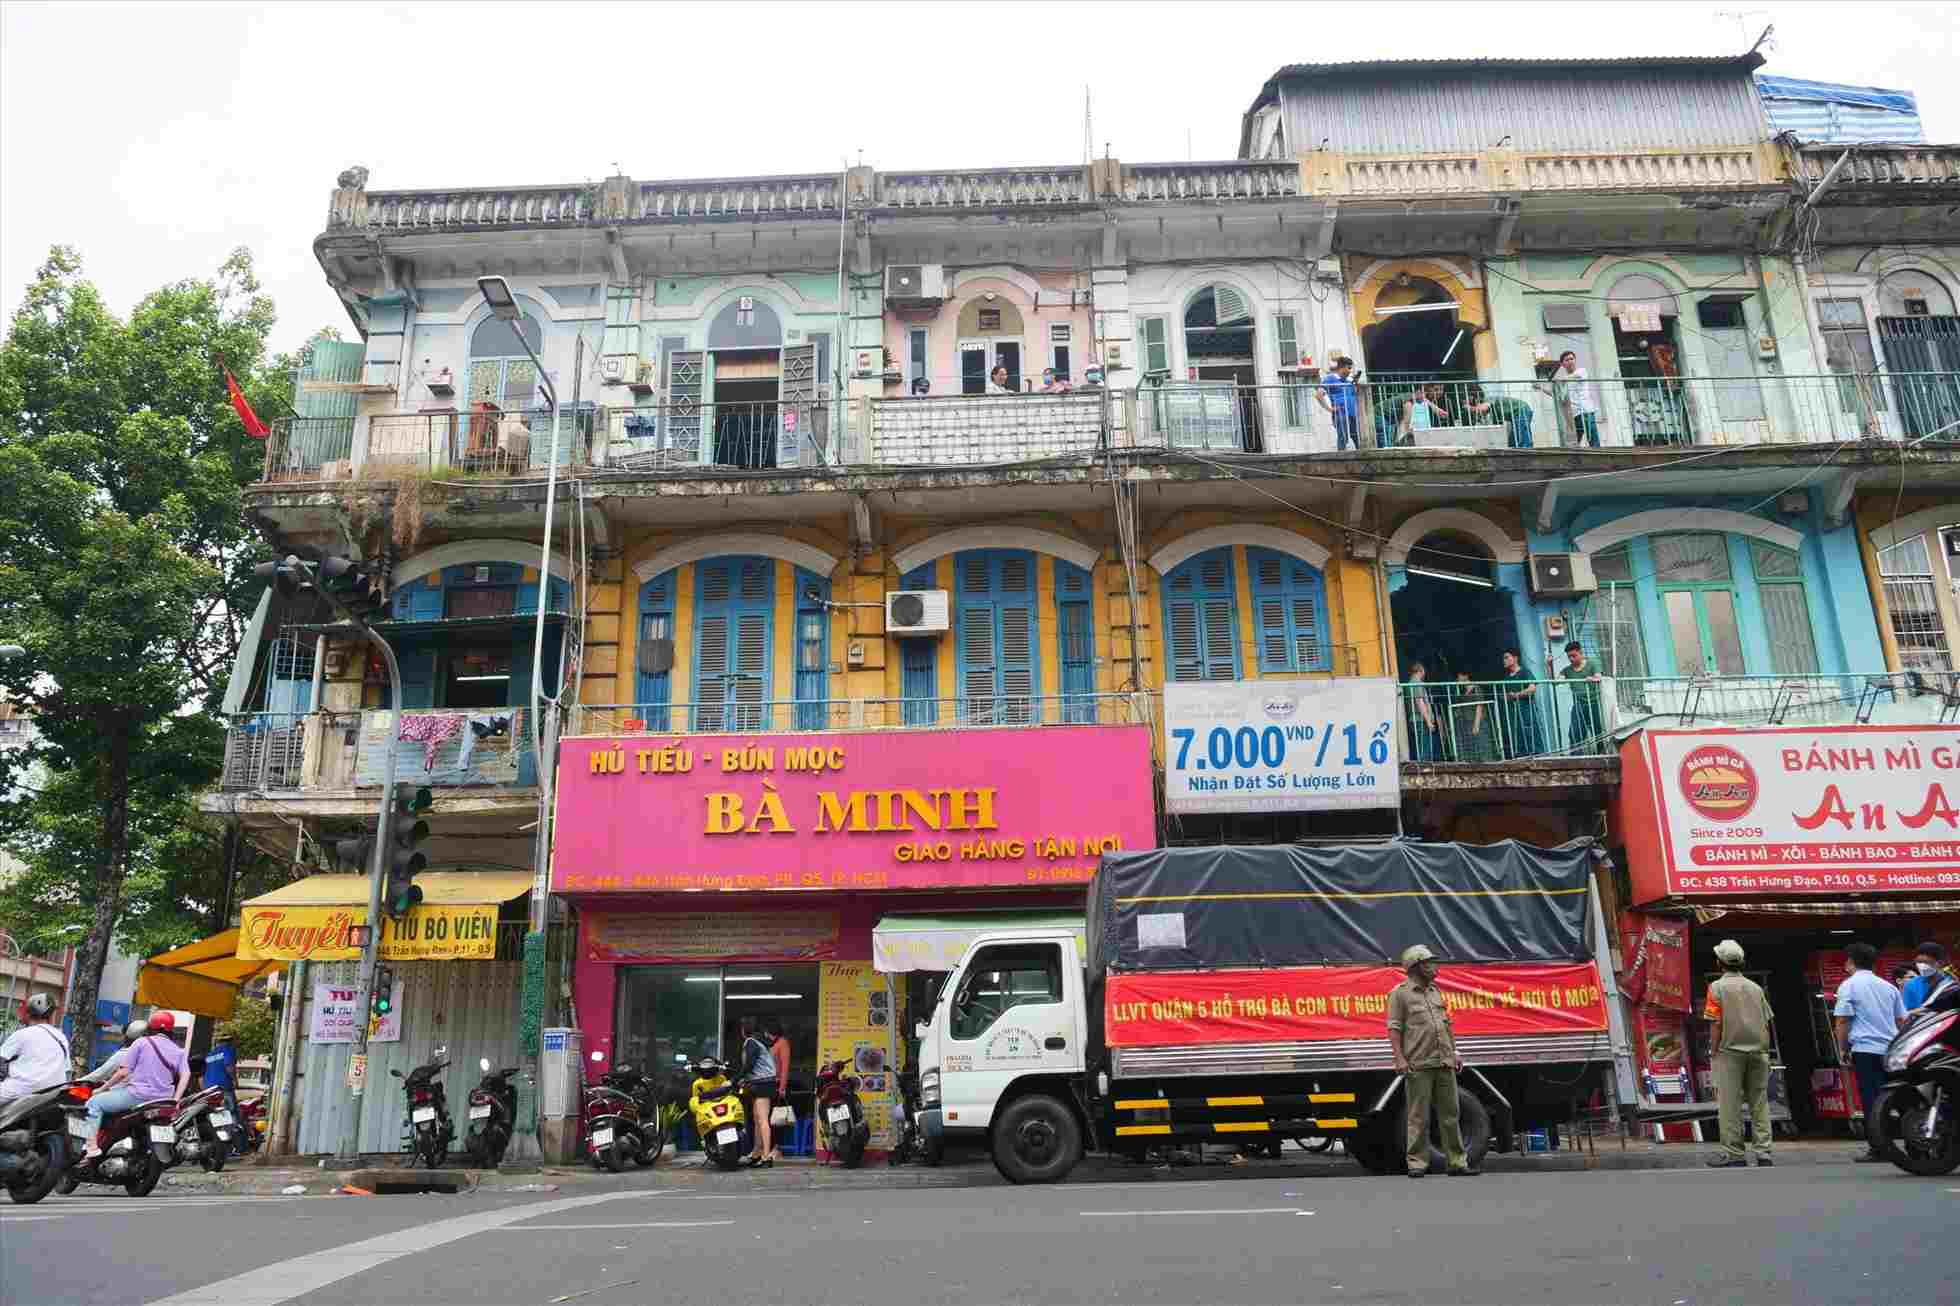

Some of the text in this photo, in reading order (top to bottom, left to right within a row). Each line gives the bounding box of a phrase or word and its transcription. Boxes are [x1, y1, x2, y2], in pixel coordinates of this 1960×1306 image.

[636, 739, 693, 774] TIẾU
[720, 742, 775, 773] BÚN
[784, 746, 845, 776] MỌC
[1171, 726, 1286, 770] 7.000
[1781, 738, 1960, 771] BÁNH MÌ G
[1188, 771, 1376, 792] Nhận Đặt Số Lượng Lớn
[703, 777, 999, 833] BÀ MINH
[1792, 783, 1887, 831] An
[896, 843, 952, 861] GIAO
[1034, 834, 1077, 861] TẬN
[1690, 828, 1724, 838] Since
[1705, 846, 1746, 861] BÁNH
[1750, 844, 1768, 861] MÌ
[1780, 844, 1807, 860] XÔI
[1819, 844, 1861, 860] BÁNH
[1865, 846, 1897, 859] BAO
[1911, 843, 1953, 858] BÁNH
[1728, 874, 1757, 887] Trần
[1759, 874, 1792, 888] Hưng
[425, 911, 448, 940] BÒ
[454, 909, 492, 940] VIÊN
[1112, 1001, 1149, 1022] LLVT
[1152, 996, 1193, 1023] QUẬN
[1237, 992, 1267, 1019] TRỢ
[1271, 991, 1292, 1017] BÀ
[1295, 995, 1328, 1017] CON
[1330, 993, 1351, 1018] TỰ
